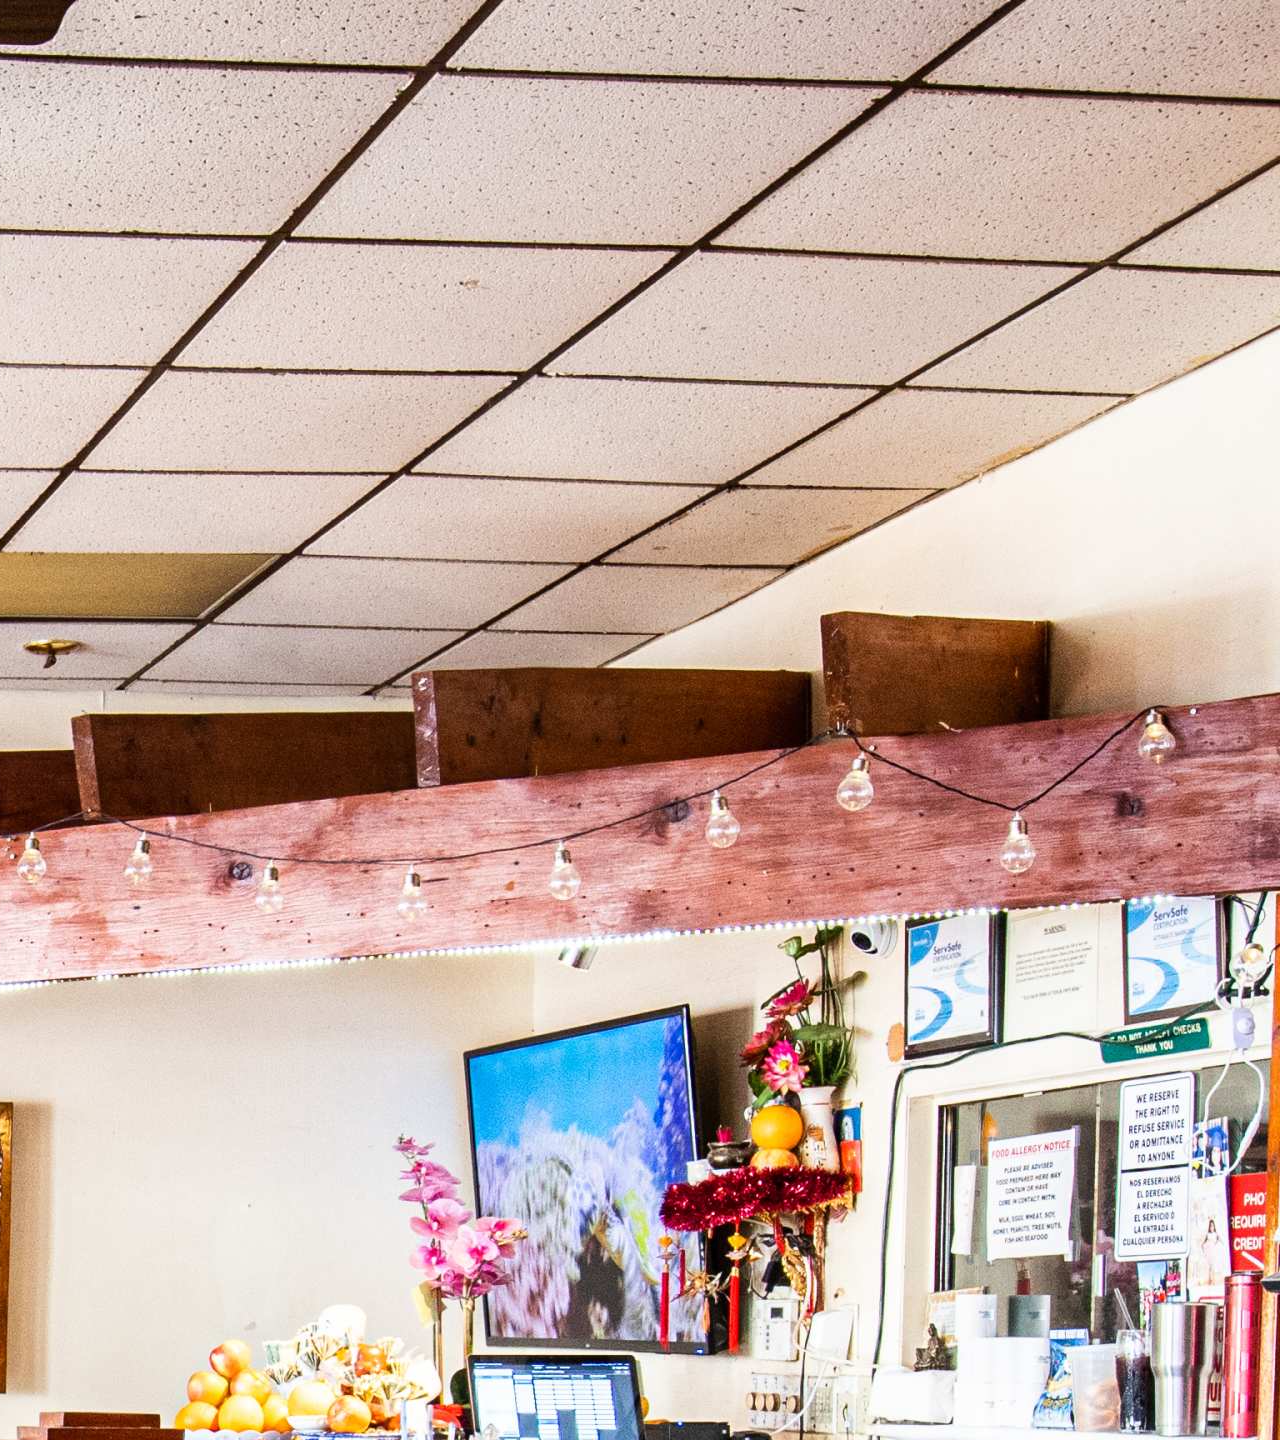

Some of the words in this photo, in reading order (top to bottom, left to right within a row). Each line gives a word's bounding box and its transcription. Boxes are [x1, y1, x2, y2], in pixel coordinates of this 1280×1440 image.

[1153, 905, 1189, 922] ServSafe
[1129, 1031, 1142, 1041] NOT
[1173, 1022, 1202, 1036] CHECKS
[1134, 1042, 1158, 1054] THANK
[1159, 1040, 1174, 1050] YOU
[1136, 1093, 1147, 1104] WE
[1149, 1089, 1180, 1103] RESERVE
[1135, 1108, 1148, 1119] THE
[1149, 1106, 1170, 1117] RIGHT
[1171, 1104, 1180, 1114] TO
[1128, 1122, 1156, 1134] REFUSE
[1156, 1118, 1185, 1132] SERVICE
[1129, 1139, 1140, 1149] OR
[1141, 1134, 1183, 1148] ADMITTANCE
[992, 1148, 1010, 1159] FOOD
[1011, 1144, 1041, 1156] ALLERGY
[1043, 1140, 1071, 1151] NOTICE
[1137, 1153, 1146, 1164] TO
[1147, 1150, 1175, 1162] ANYONE
[1129, 1179, 1142, 1187] NOS
[1142, 1175, 1182, 1187] RESERVAMOS
[1136, 1190, 1144, 1199] EL
[1145, 1187, 1172, 1198] DERECHO
[1243, 1191, 1266, 1206] PHO
[1142, 1199, 1173, 1210] RECHAZAR
[1134, 1214, 1142, 1222] EL
[1142, 1212, 1169, 1222] SERVICIO
[1134, 1226, 1141, 1234] LA
[1142, 1224, 1169, 1233] ENTRADA
[1122, 1236, 1156, 1247] CUALQUIER
[1156, 1234, 1184, 1245] PERSONA
